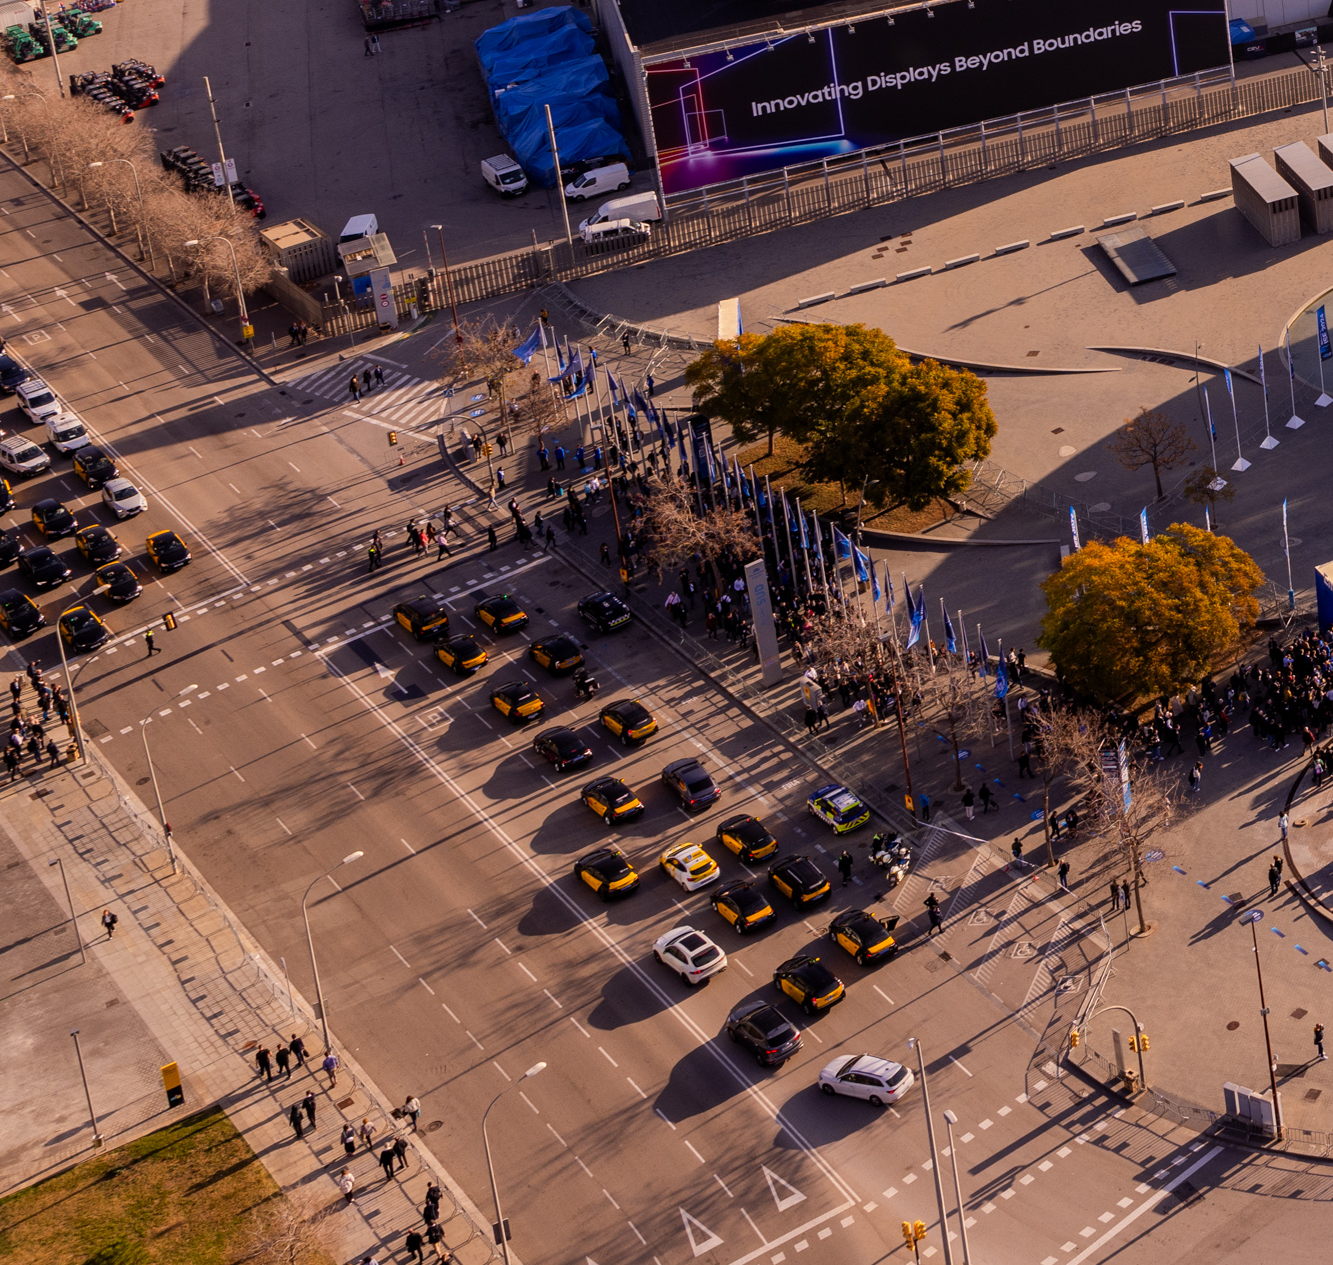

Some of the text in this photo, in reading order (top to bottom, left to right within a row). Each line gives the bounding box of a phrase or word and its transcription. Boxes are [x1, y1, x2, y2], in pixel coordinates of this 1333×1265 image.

[750, 19, 1143, 118] Innovating Displays Beyond Boundaries
[754, 583, 766, 607] SUD
